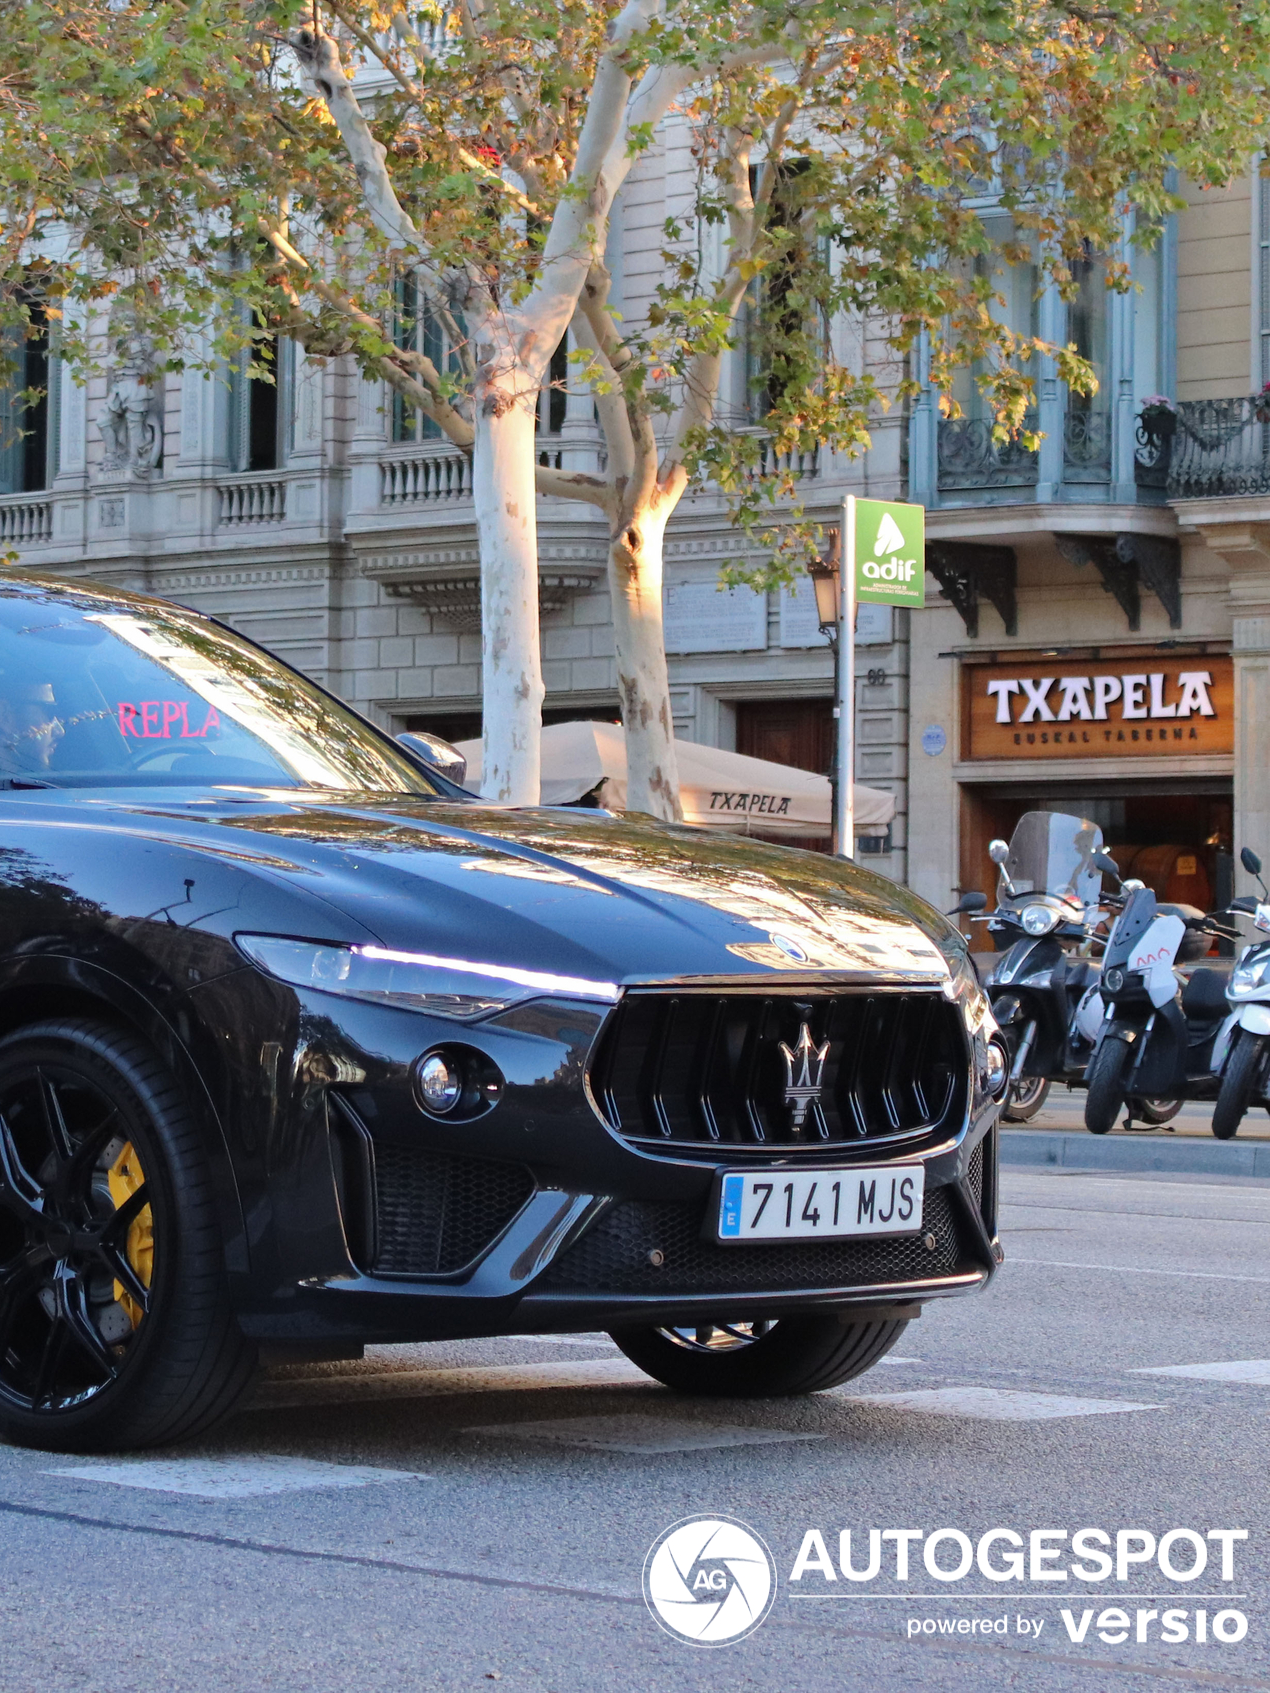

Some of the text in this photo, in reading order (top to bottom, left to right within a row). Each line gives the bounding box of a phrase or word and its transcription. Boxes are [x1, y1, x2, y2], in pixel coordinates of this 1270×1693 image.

[862, 556, 917, 581] adif
[988, 671, 1216, 723] TXAPELA
[1013, 727, 1198, 745] EUSKAL TABERNA
[710, 792, 792, 815] TXAPELA
[750, 1177, 915, 1229] 7141 MJS
[726, 1213, 736, 1226] E
